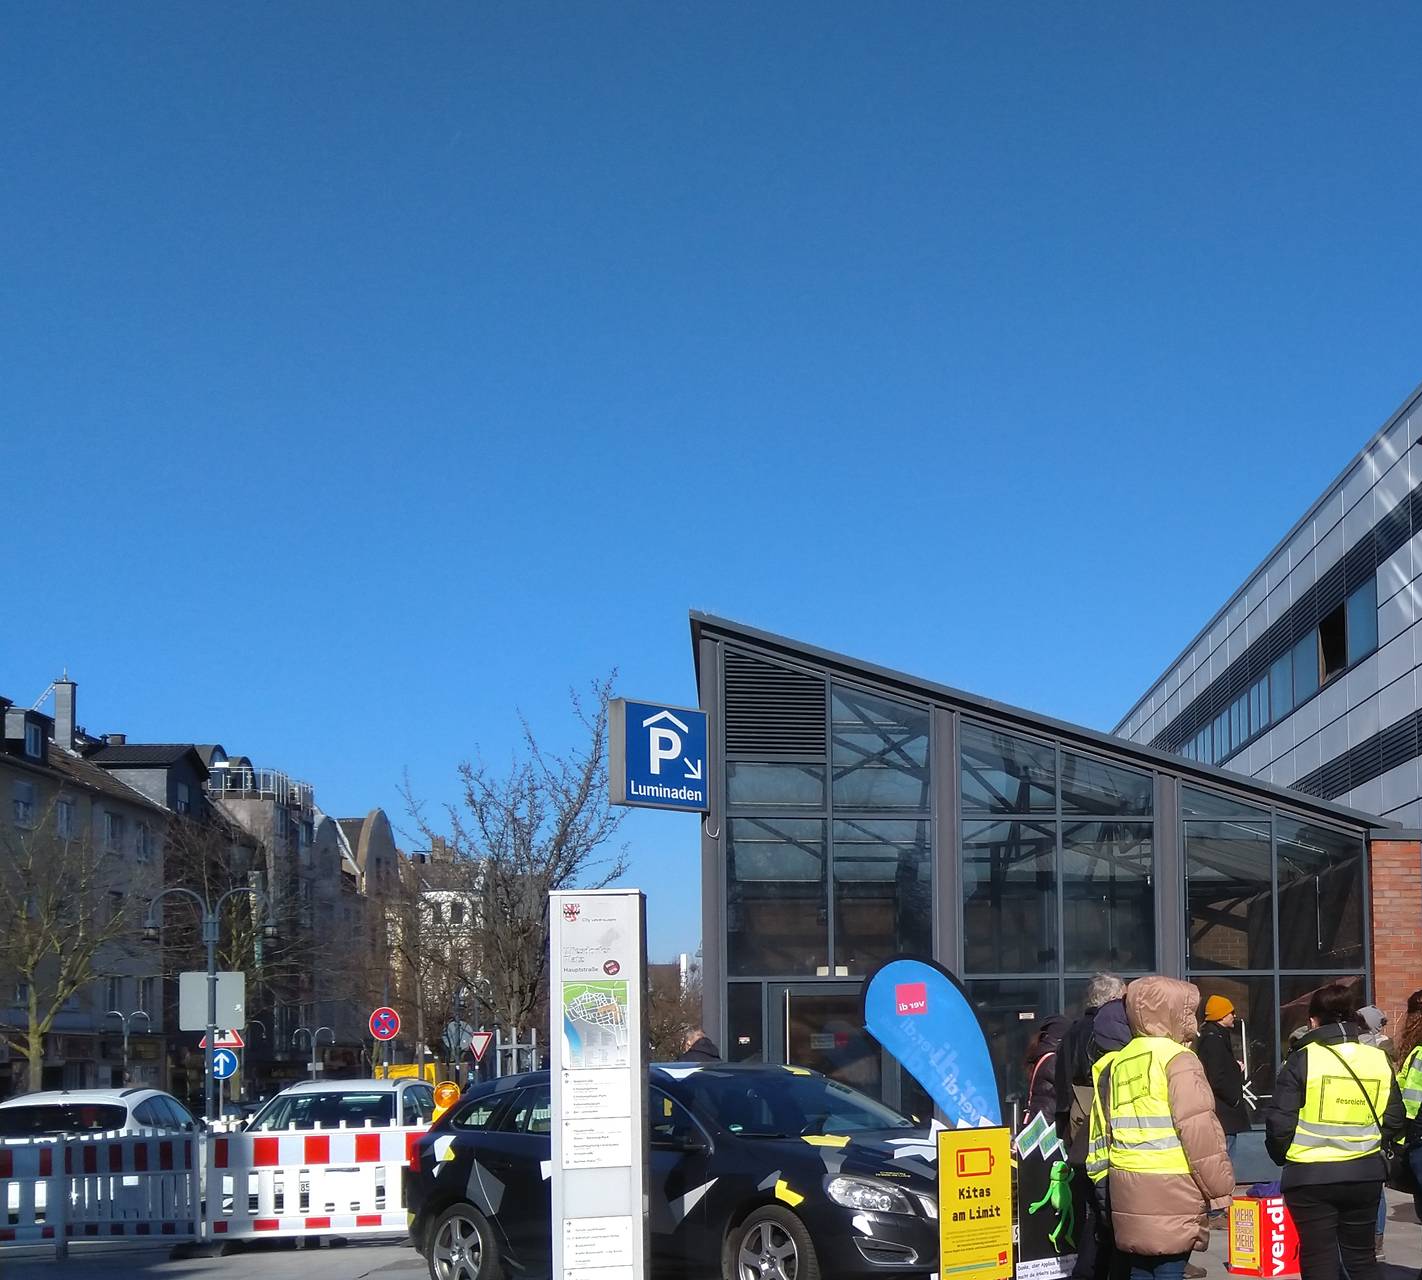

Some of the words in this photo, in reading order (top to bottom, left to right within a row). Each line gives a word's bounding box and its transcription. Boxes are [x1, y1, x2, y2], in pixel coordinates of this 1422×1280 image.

[650, 727, 682, 775] P
[630, 780, 702, 802] Luminaden
[1335, 1097, 1366, 1106] #esreicht
[958, 1186, 991, 1200] Kitas
[952, 1211, 966, 1222] am
[969, 1206, 1001, 1220] Limit
[1235, 1208, 1254, 1222] MEHR
[1235, 1234, 1255, 1249] MEHR
[1266, 1198, 1285, 1276] ver.di
